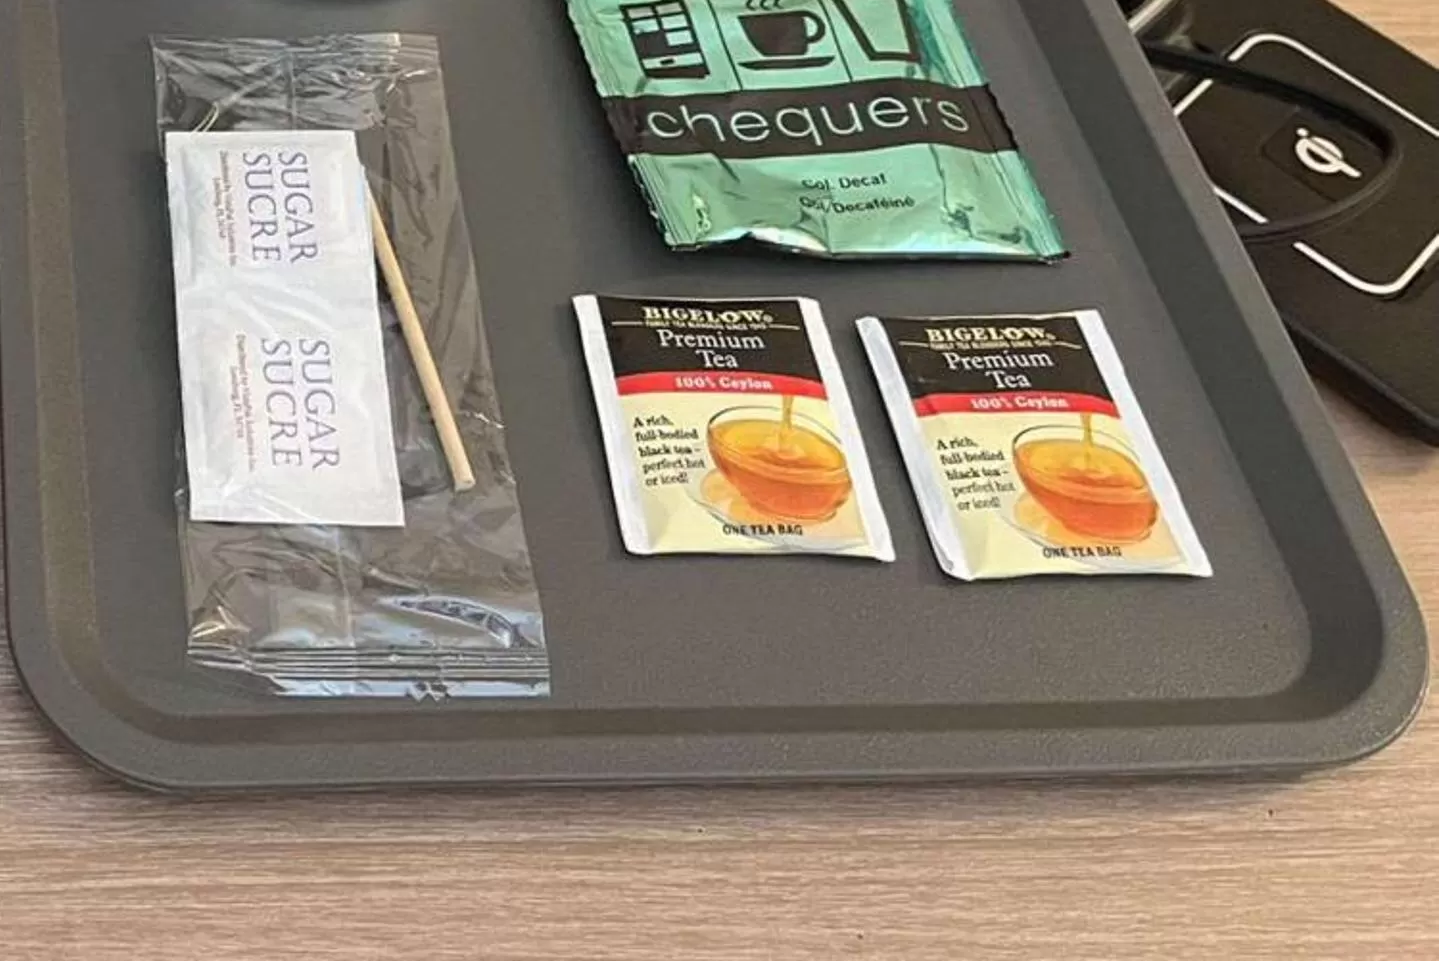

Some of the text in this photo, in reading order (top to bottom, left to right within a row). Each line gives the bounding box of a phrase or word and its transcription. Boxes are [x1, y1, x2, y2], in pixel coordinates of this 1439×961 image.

[646, 94, 970, 147] chequers
[242, 152, 282, 262] SUCRE
[278, 151, 319, 264] SUGAR
[656, 329, 766, 349] Premium
[695, 350, 739, 369] Tea
[942, 350, 1054, 370] Premium
[675, 376, 774, 391] 100% Ceylon
[985, 370, 1032, 389] Tea
[260, 338, 303, 468] SUCRE
[298, 338, 341, 471] SUGAR
[970, 395, 1070, 410] 100% Ceylon
[633, 416, 645, 429] A
[638, 443, 673, 458] black
[937, 438, 949, 451] A
[642, 457, 685, 475] perfect
[945, 466, 982, 481] black
[951, 481, 995, 499] perfect
[722, 523, 804, 536] ONE TEA BAG
[1042, 545, 1123, 559] ONE TEA BAG
